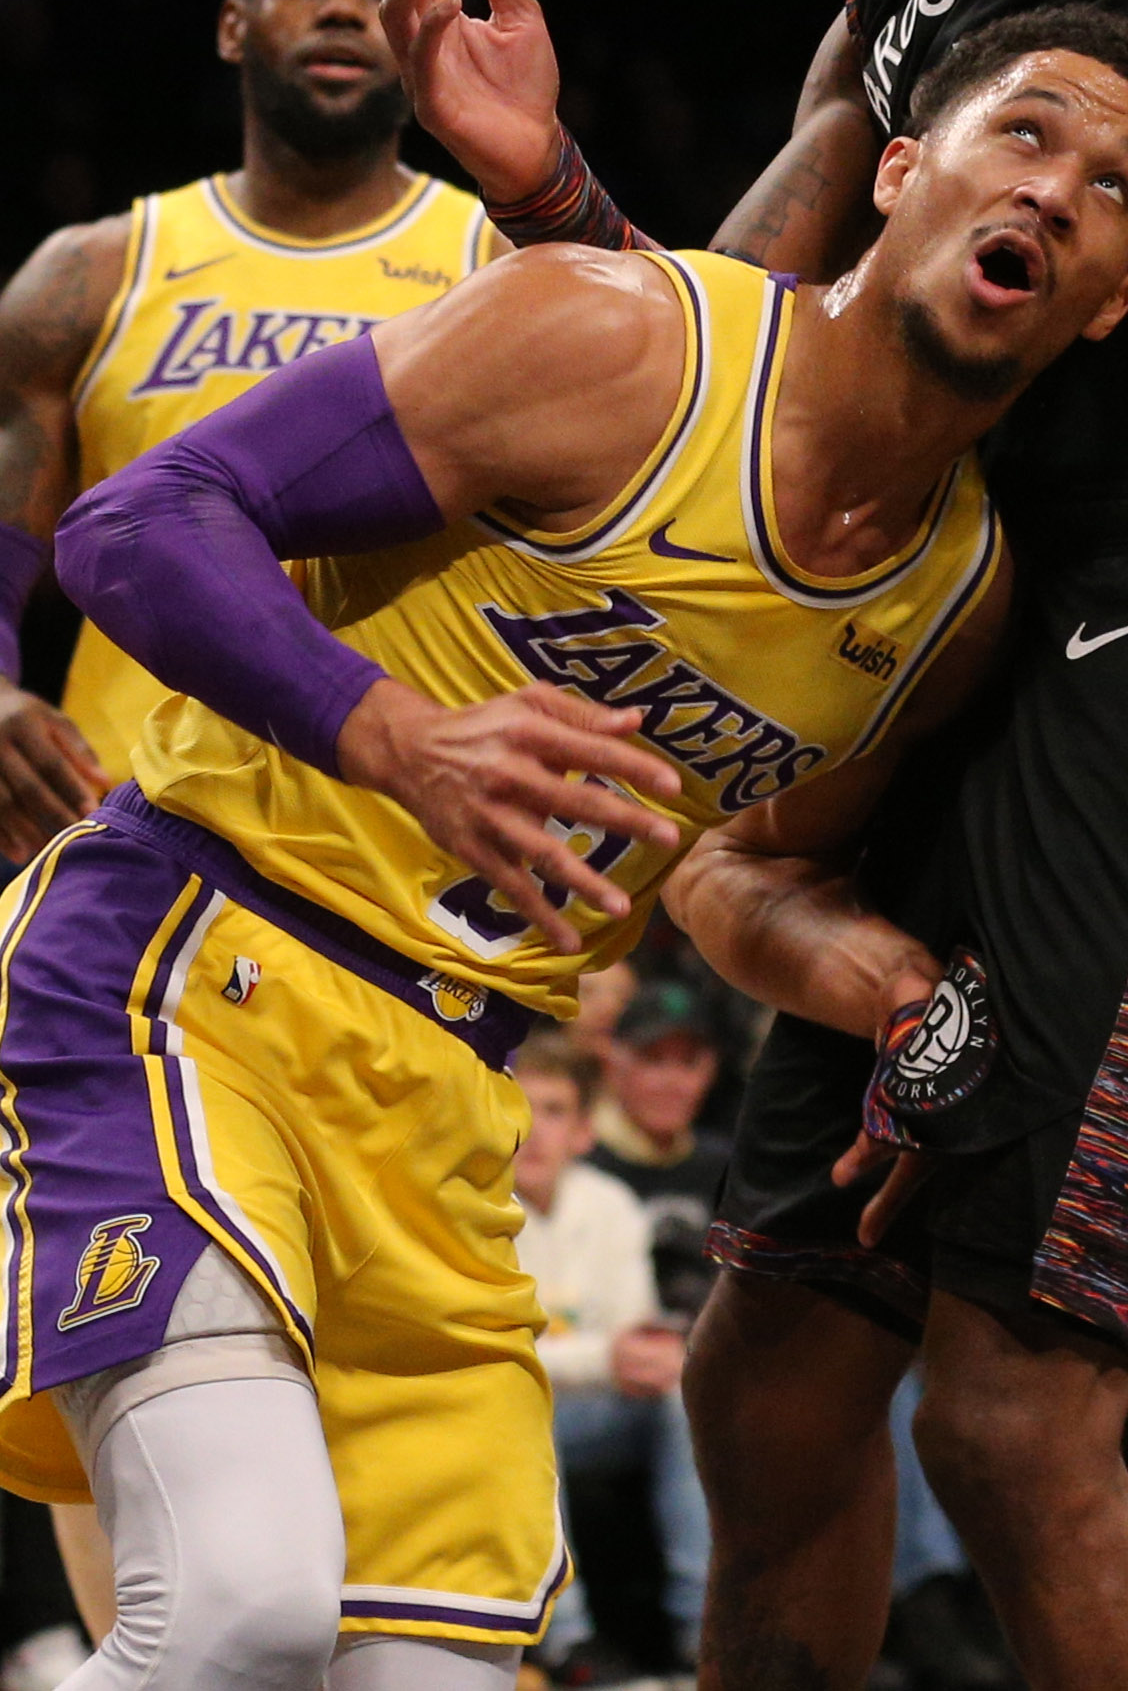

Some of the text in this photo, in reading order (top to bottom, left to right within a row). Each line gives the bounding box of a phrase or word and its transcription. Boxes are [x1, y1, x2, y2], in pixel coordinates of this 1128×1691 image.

[127, 295, 390, 401] LAKE
[839, 621, 897, 681] wish
[475, 586, 829, 815] LAKERS
[946, 962, 989, 1049] OKLYN
